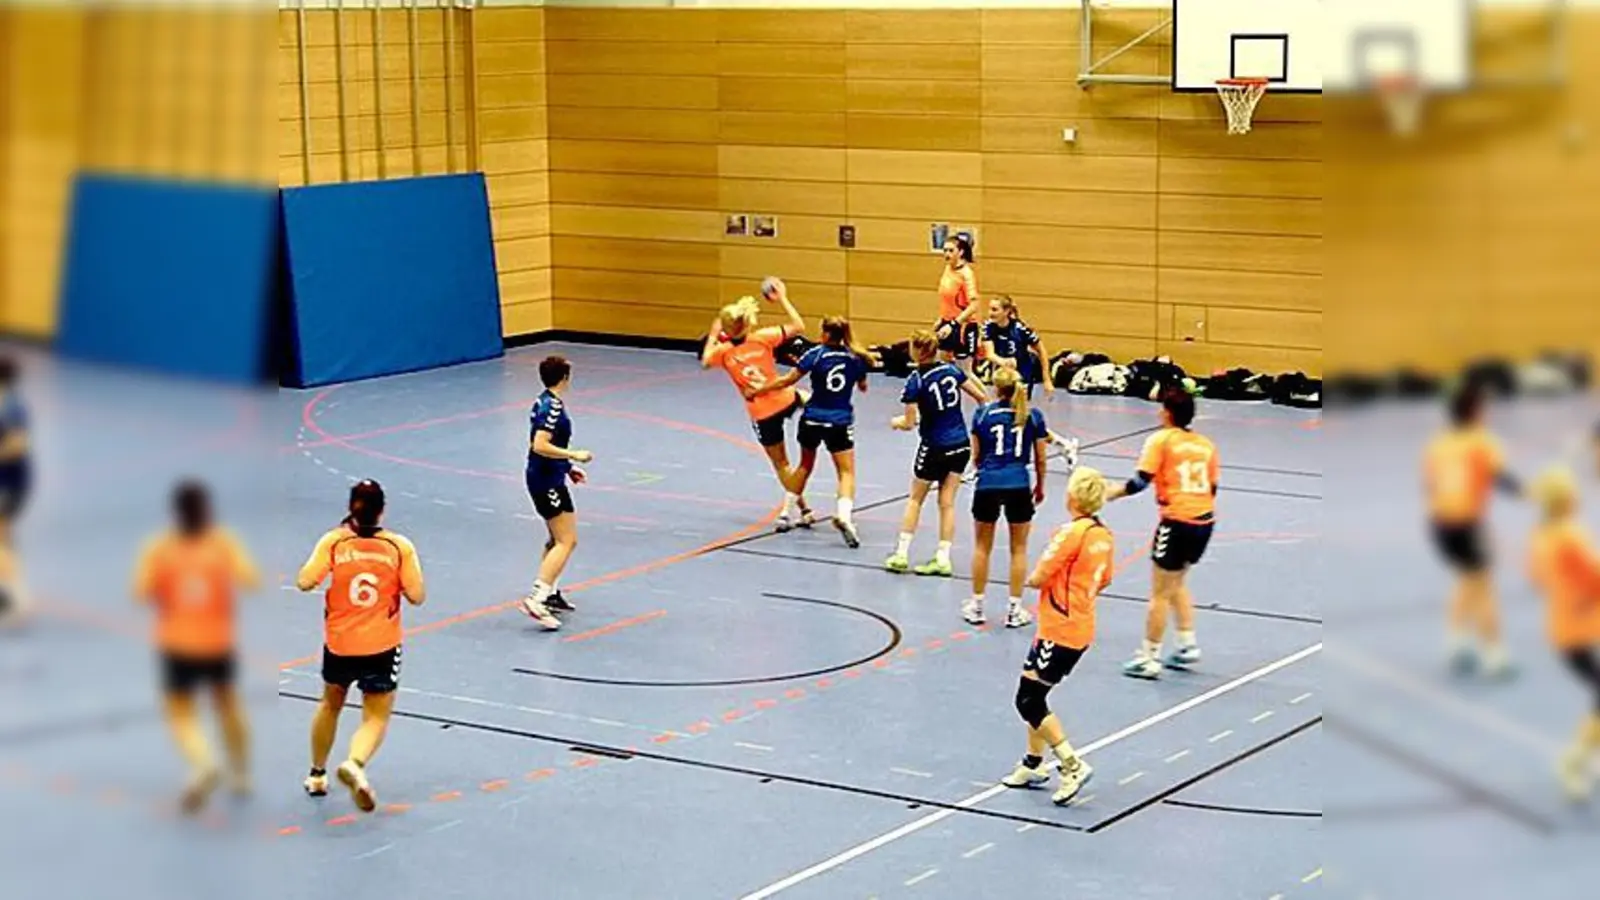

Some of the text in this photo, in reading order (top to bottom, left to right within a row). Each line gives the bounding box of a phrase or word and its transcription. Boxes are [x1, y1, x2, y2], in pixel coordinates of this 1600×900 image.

[1007, 340, 1017, 354] 3
[826, 363, 846, 392] 6
[928, 376, 959, 411] 13
[990, 424, 1023, 457] 11
[1176, 461, 1210, 494] 13
[349, 573, 379, 608] 6
